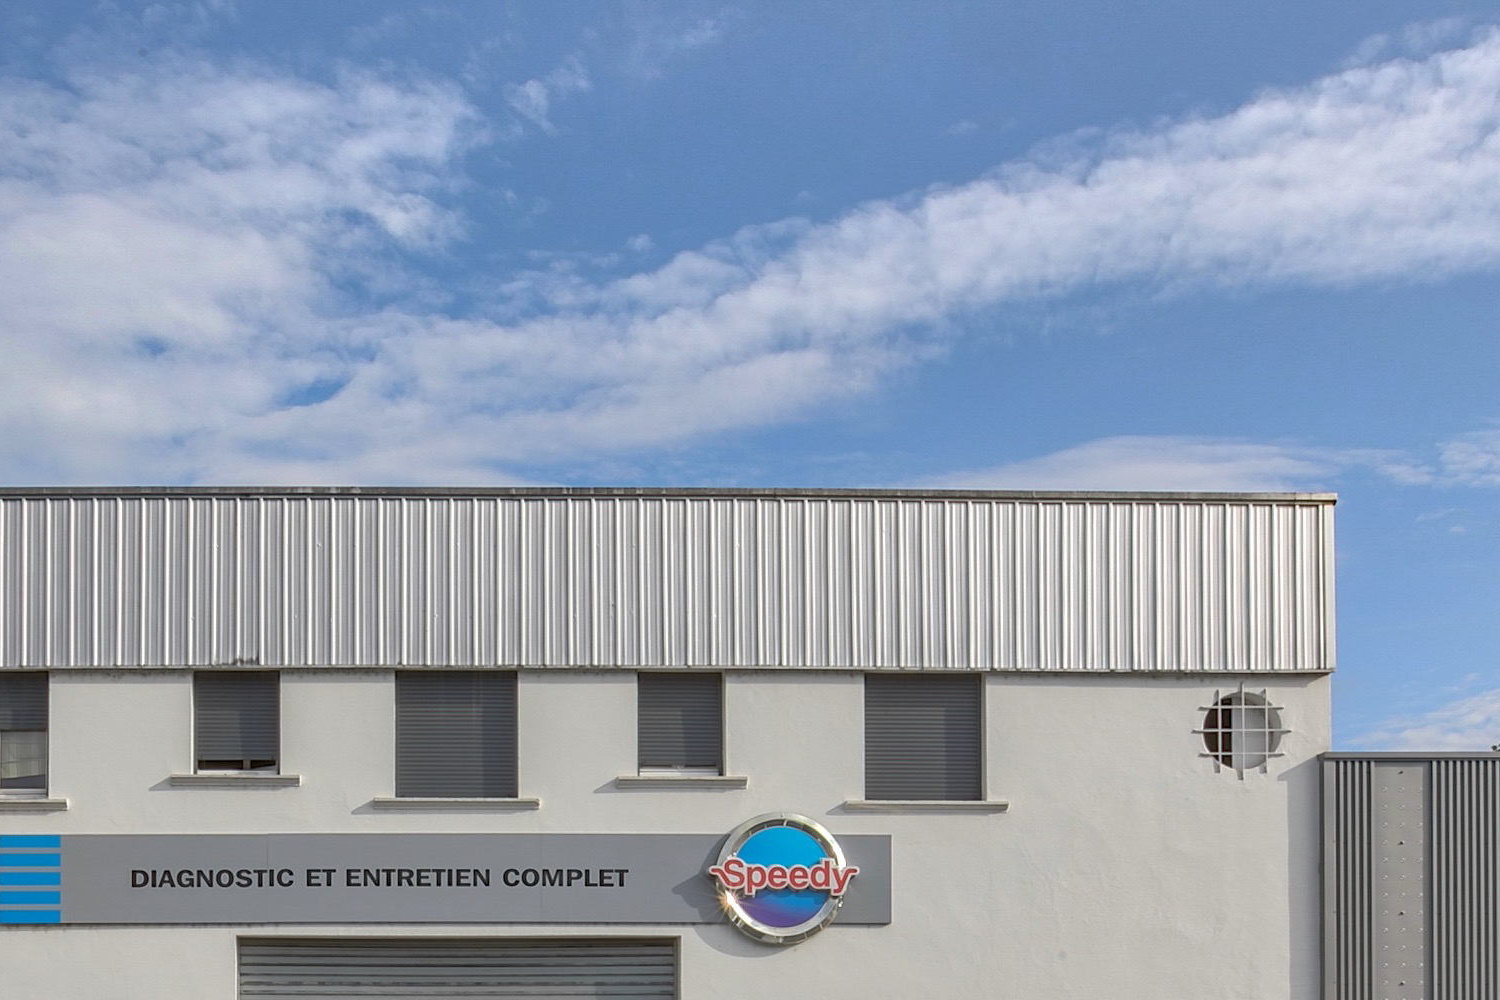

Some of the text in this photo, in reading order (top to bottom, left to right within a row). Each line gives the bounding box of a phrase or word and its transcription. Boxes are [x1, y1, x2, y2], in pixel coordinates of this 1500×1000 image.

[130, 867, 630, 889] DIAGNOSTIC ET ENTRETIEN COMPLET
[710, 859, 858, 895] Speedy
